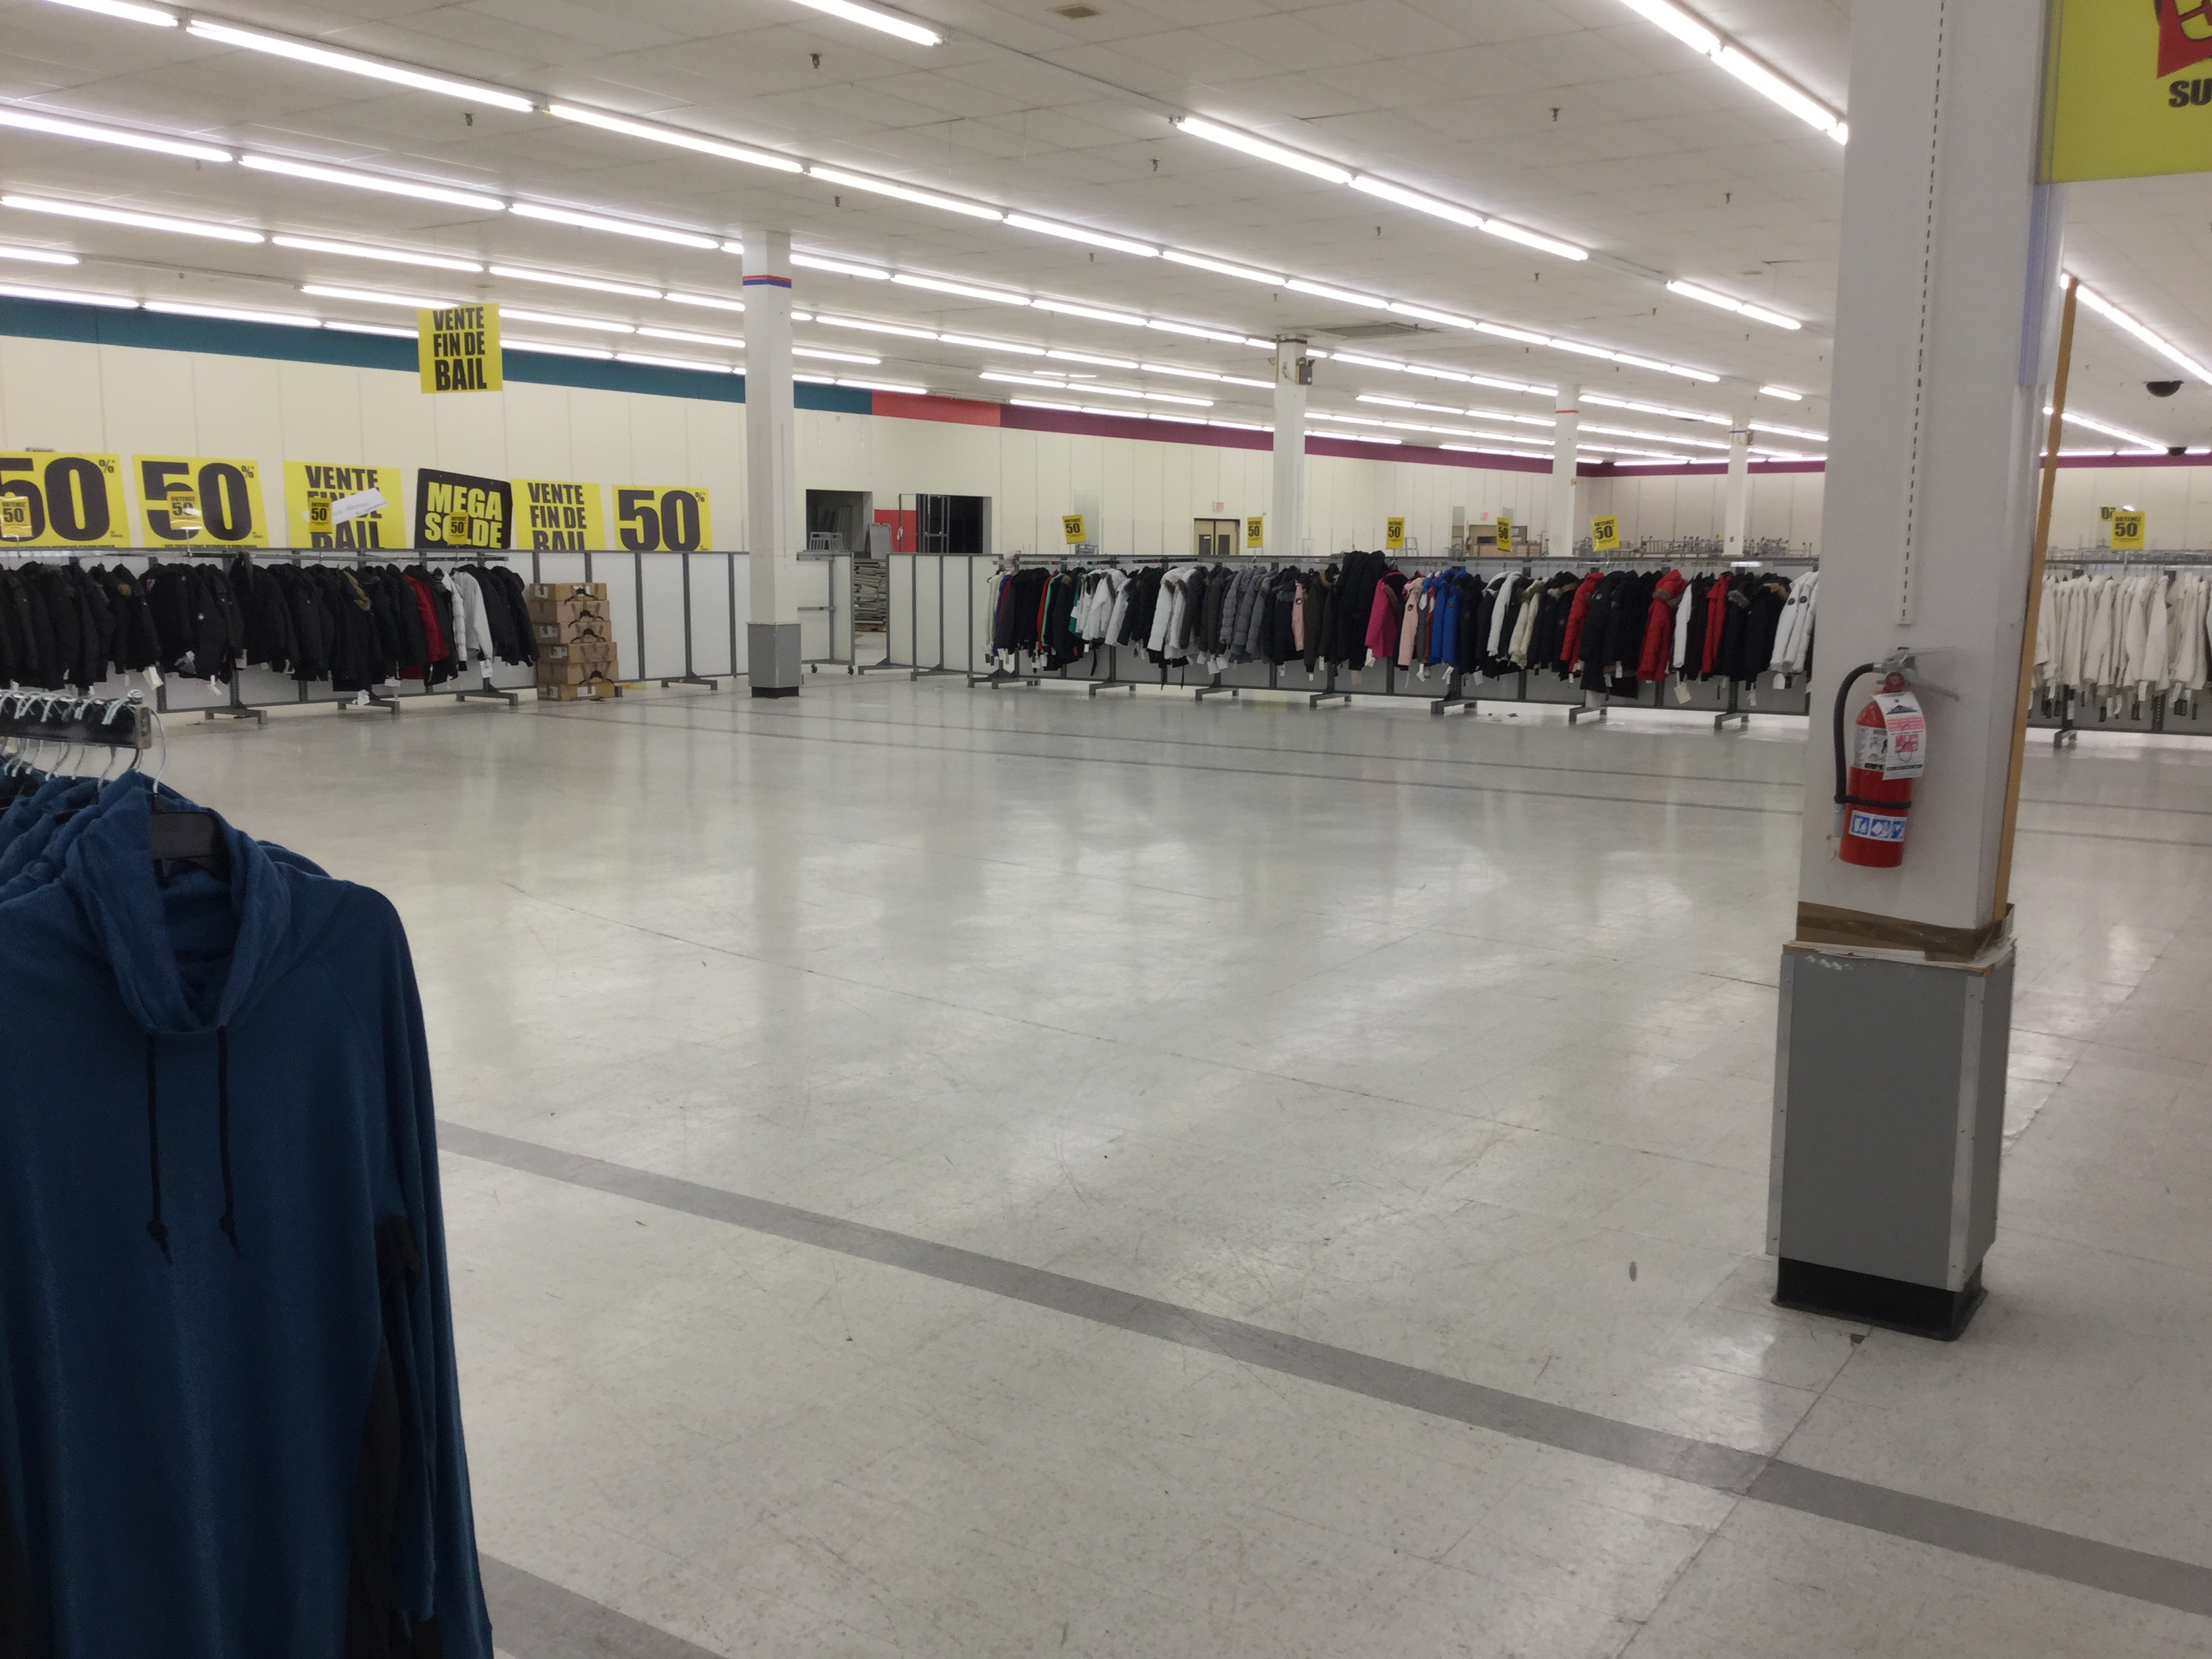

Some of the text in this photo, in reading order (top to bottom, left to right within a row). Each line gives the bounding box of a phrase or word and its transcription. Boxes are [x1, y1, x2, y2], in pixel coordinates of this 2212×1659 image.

[2169, 78, 2212, 108] SU
[432, 307, 485, 331] VENTE
[433, 331, 485, 357] FIN DE
[434, 358, 487, 390] BAIL
[304, 465, 380, 491] VENTE
[427, 482, 502, 521] MEGA
[527, 483, 584, 505] VENTE
[3, 508, 24, 523] 50
[172, 502, 193, 516] 50
[311, 508, 327, 521] 50
[530, 505, 587, 529] FIN DE
[425, 512, 502, 549] SDE
[451, 521, 464, 533] 50
[1065, 523, 1080, 534] 50
[1248, 525, 1260, 537] 50
[1388, 526, 1401, 538] 50
[1498, 527, 1508, 539] 50
[1594, 525, 1613, 539] 50
[2114, 523, 2137, 537] 50
